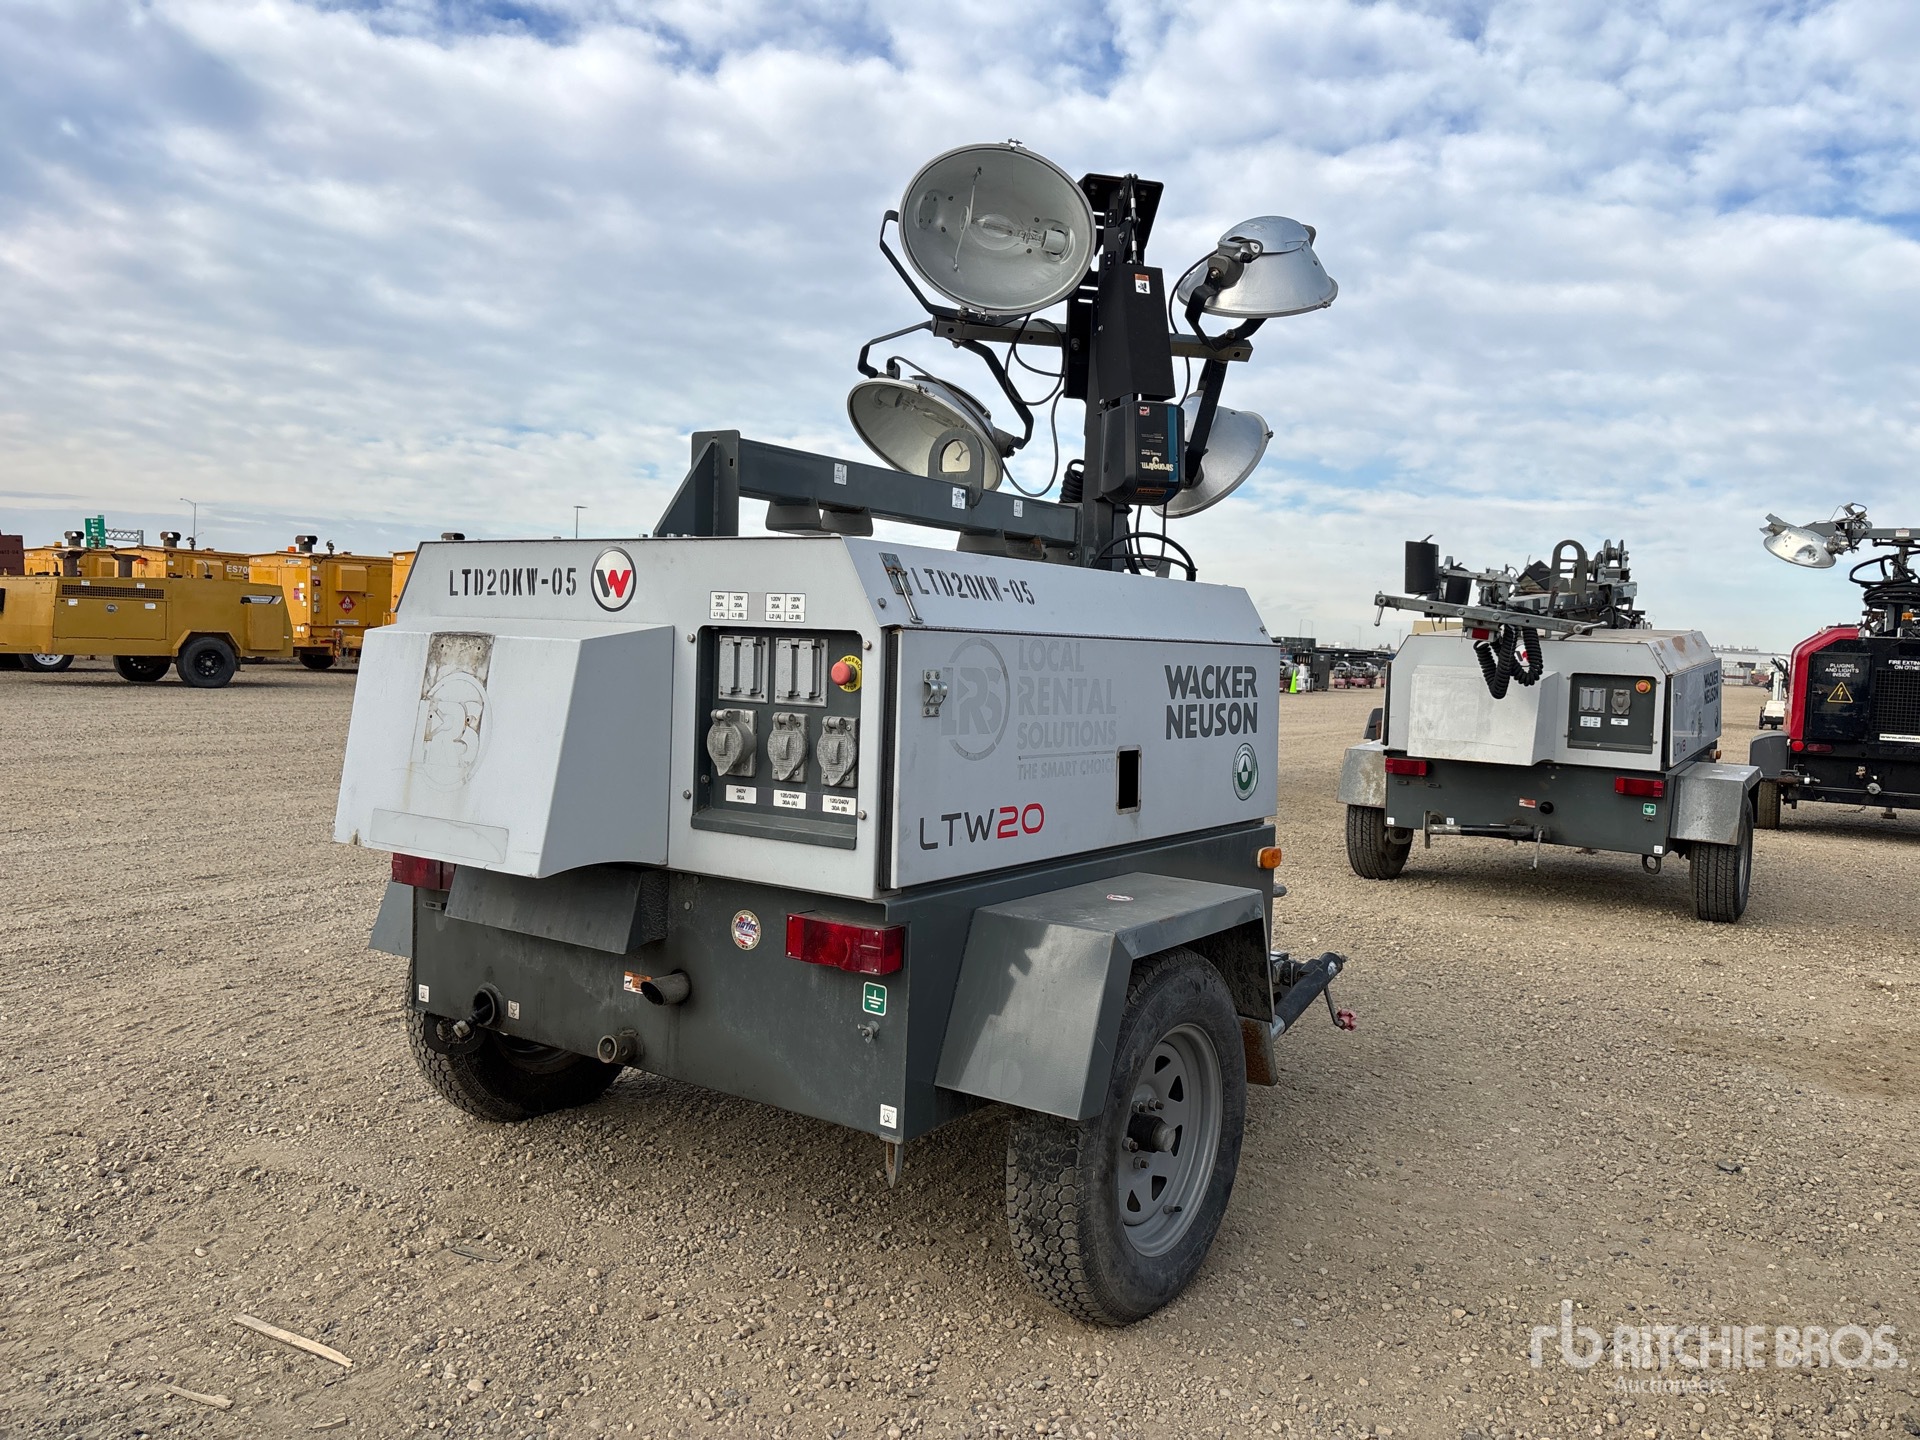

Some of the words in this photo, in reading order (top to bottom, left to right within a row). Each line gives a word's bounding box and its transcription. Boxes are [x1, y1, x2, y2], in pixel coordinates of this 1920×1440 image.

[449, 567, 577, 597] LTD20KW-05
[911, 567, 1035, 605] LTD20KW-05
[1018, 639, 1085, 672] LOCAL
[1017, 676, 1117, 716] RENTAL
[1164, 664, 1258, 700] WACKER
[1016, 720, 1117, 750] SOLUTIONS
[1165, 702, 1258, 740] NEUSON
[1017, 762, 1038, 780] THE
[1041, 760, 1078, 779] SMART
[919, 802, 1045, 851] LTW20
